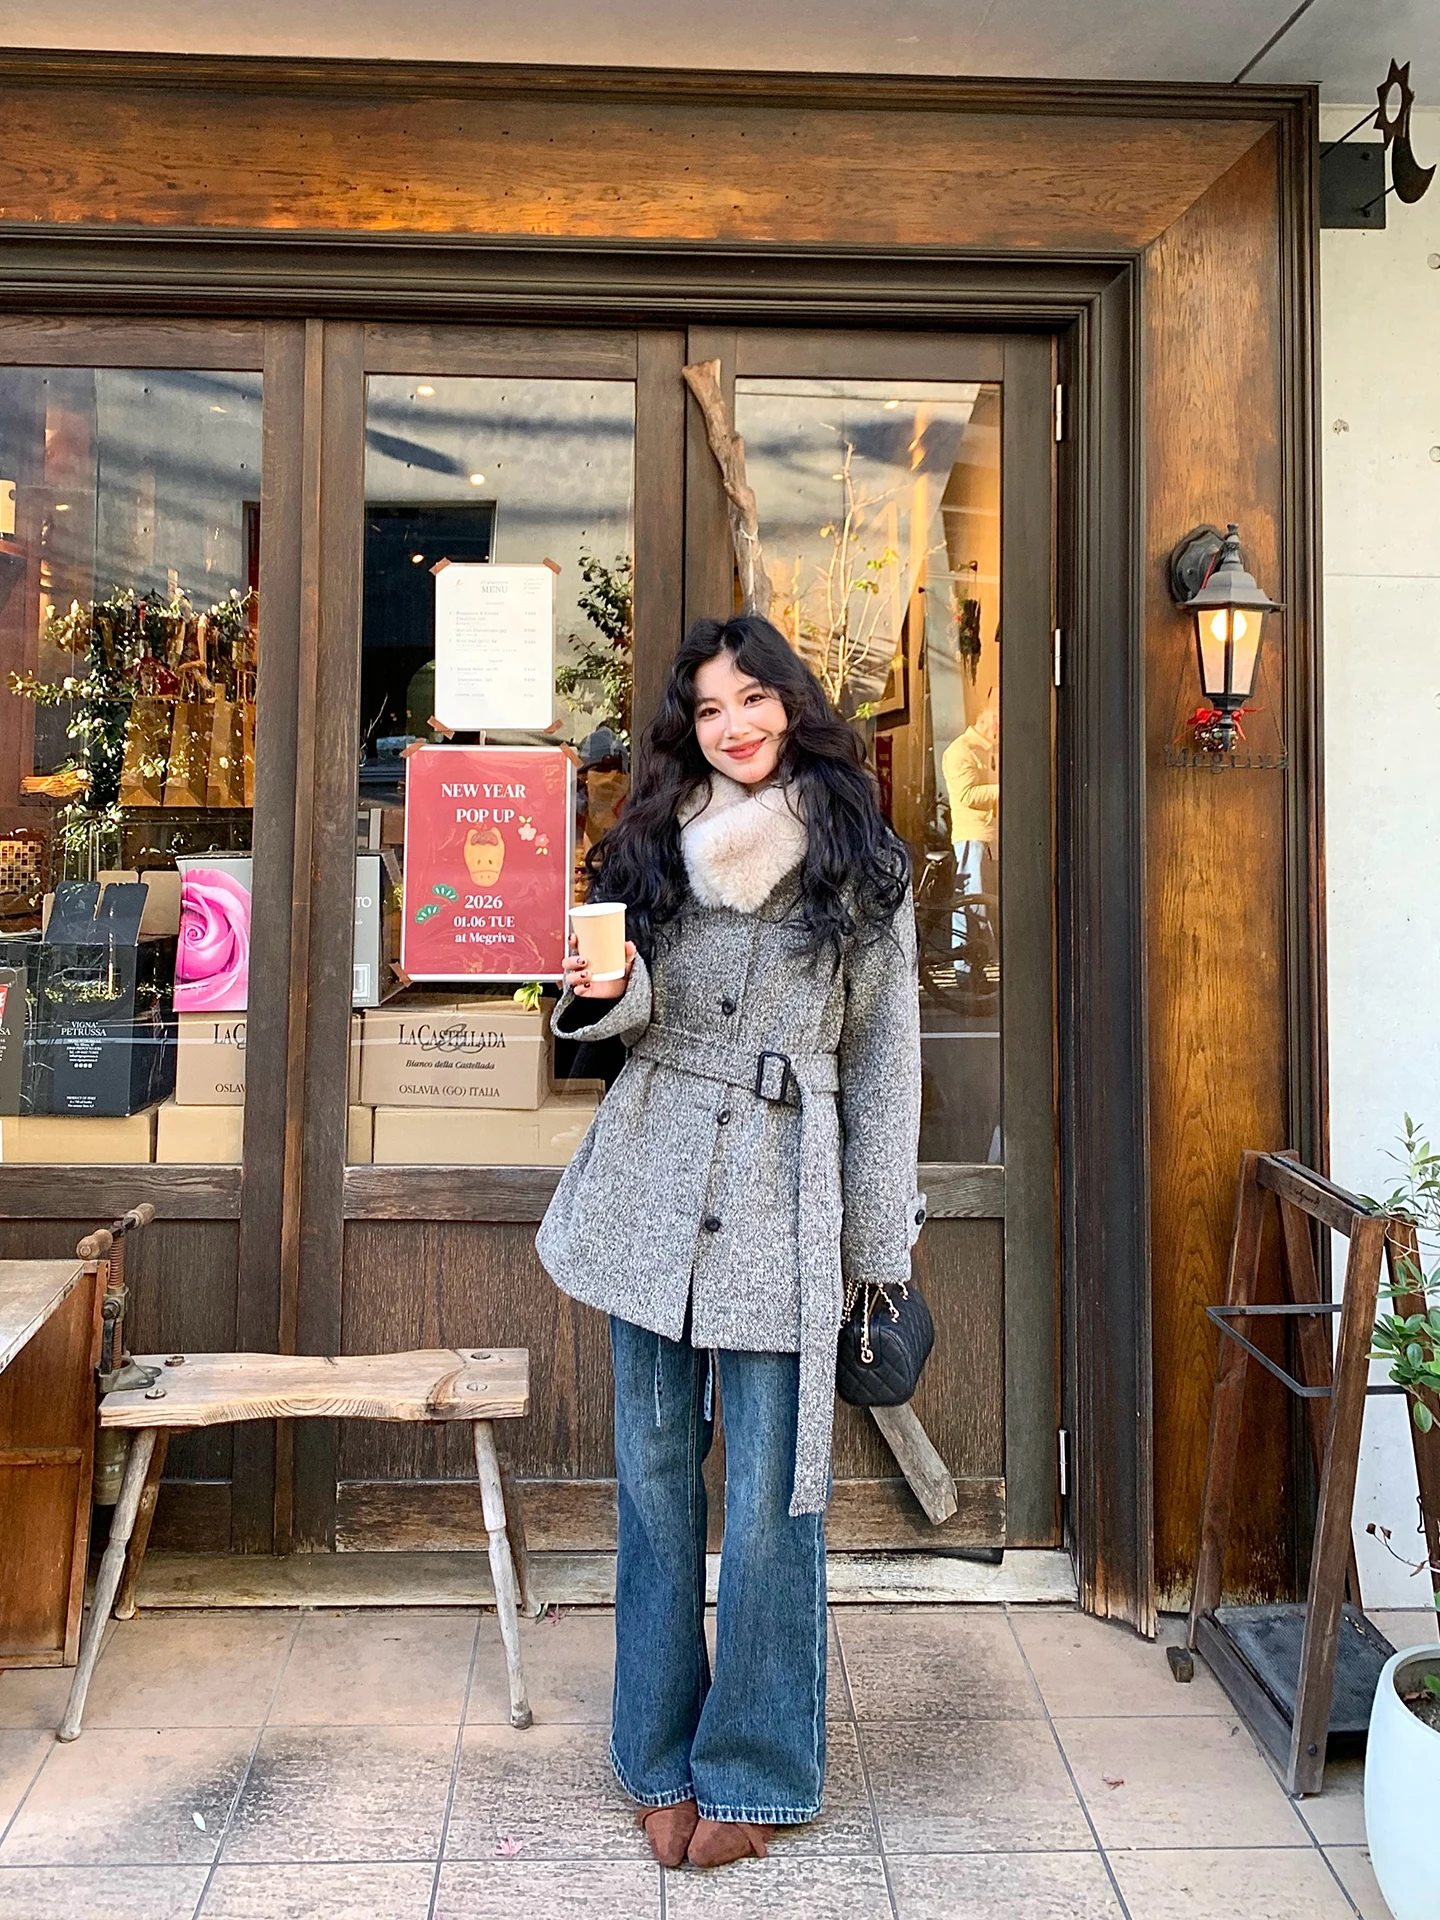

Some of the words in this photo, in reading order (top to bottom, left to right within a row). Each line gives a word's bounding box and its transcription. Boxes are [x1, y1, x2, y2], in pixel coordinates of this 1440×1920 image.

[441, 783, 480, 798] NEW
[482, 783, 526, 799] YEAR
[456, 808, 489, 823] POP
[493, 809, 515, 823] UP
[464, 895, 503, 909] 2026
[453, 916, 486, 928] 01.06
[488, 916, 515, 928] TUE
[454, 933, 467, 943] at
[469, 932, 515, 946] Megriva
[61, 1028, 107, 1036] PETRUSSA
[405, 1059, 433, 1068] Bianco
[434, 1060, 453, 1069] della
[455, 1061, 495, 1070] Castellada
[399, 1084, 440, 1095] OSLAVIA
[442, 1086, 467, 1096] (GO)
[469, 1086, 500, 1097] ITALIA
